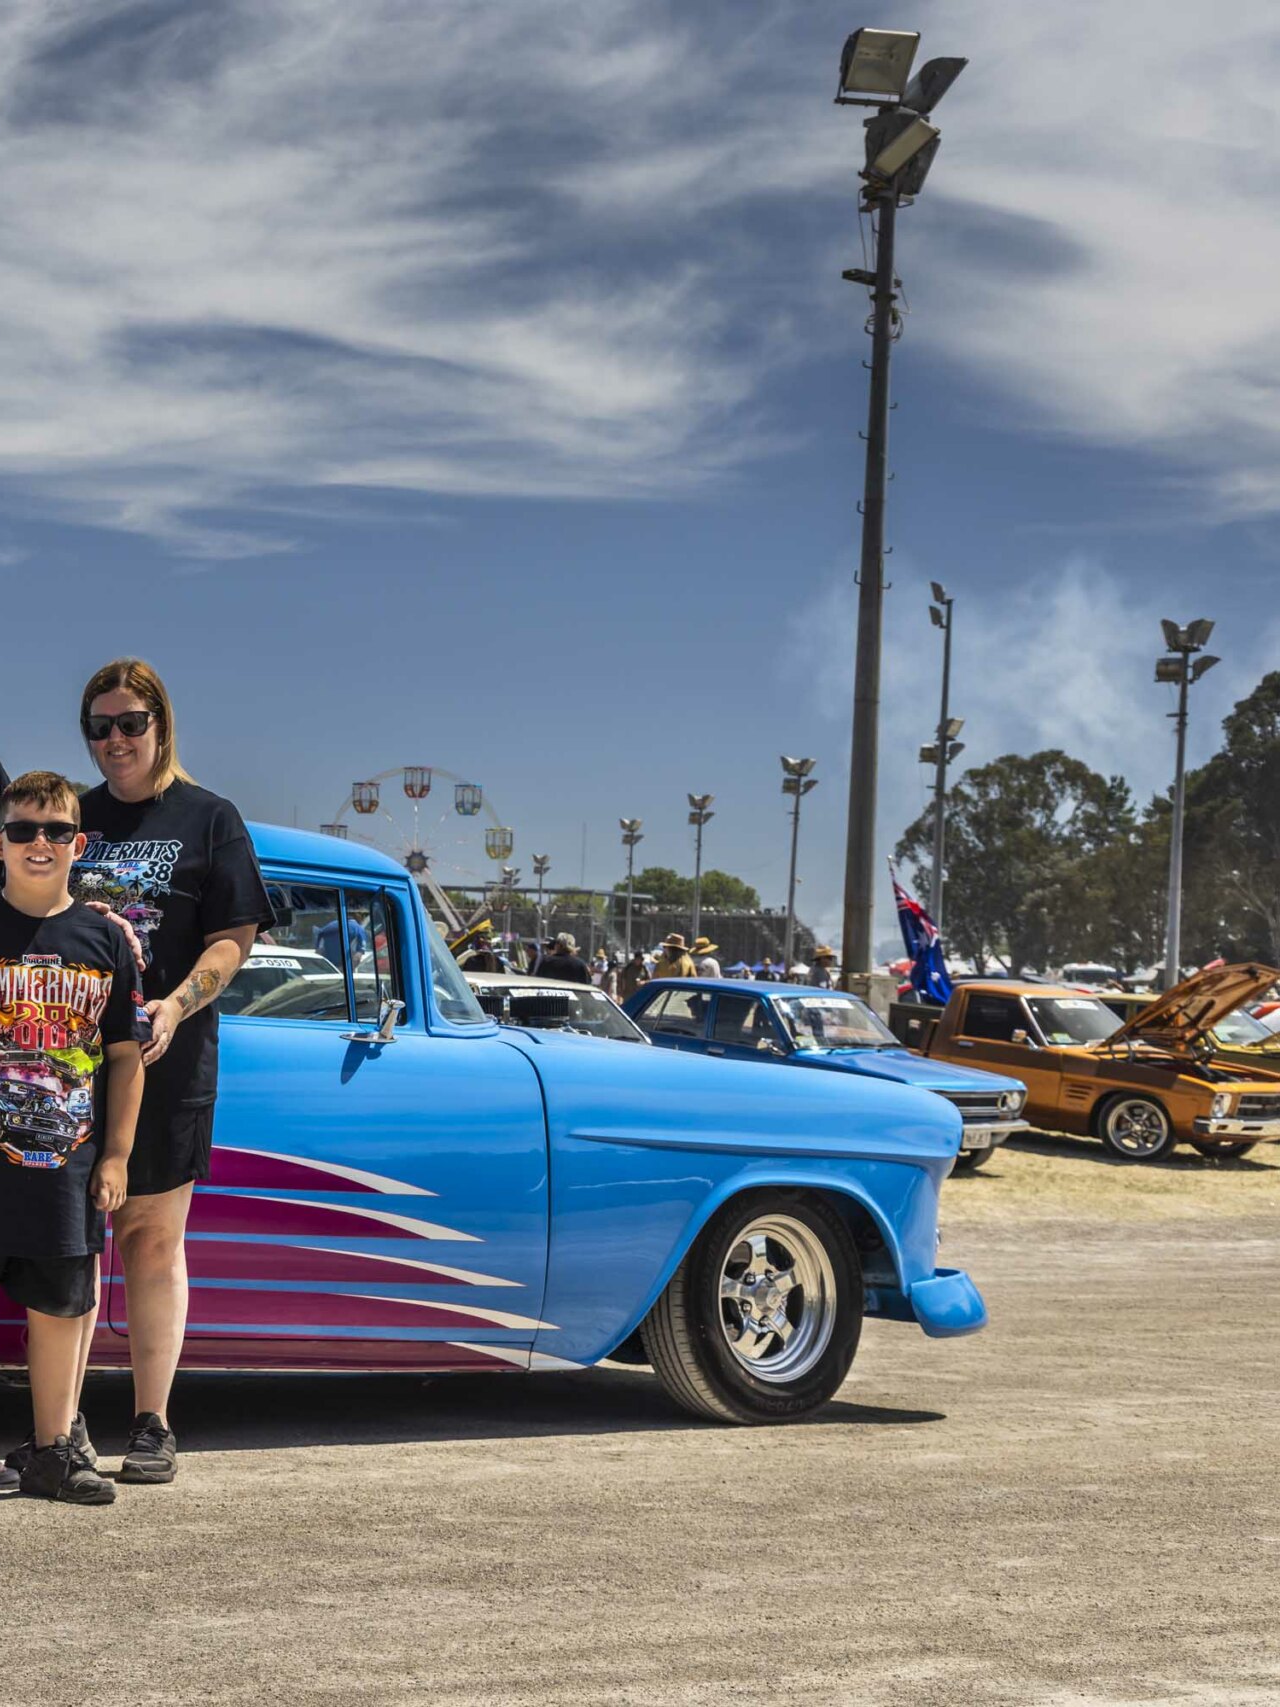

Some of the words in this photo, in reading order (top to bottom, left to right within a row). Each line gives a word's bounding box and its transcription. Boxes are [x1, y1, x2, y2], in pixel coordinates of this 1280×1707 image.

[141, 861, 174, 884] 38
[22, 954, 62, 966] MACHINE
[266, 959, 293, 967] 0510
[13, 1002, 70, 1050] 38
[23, 1150, 53, 1162] RARE
